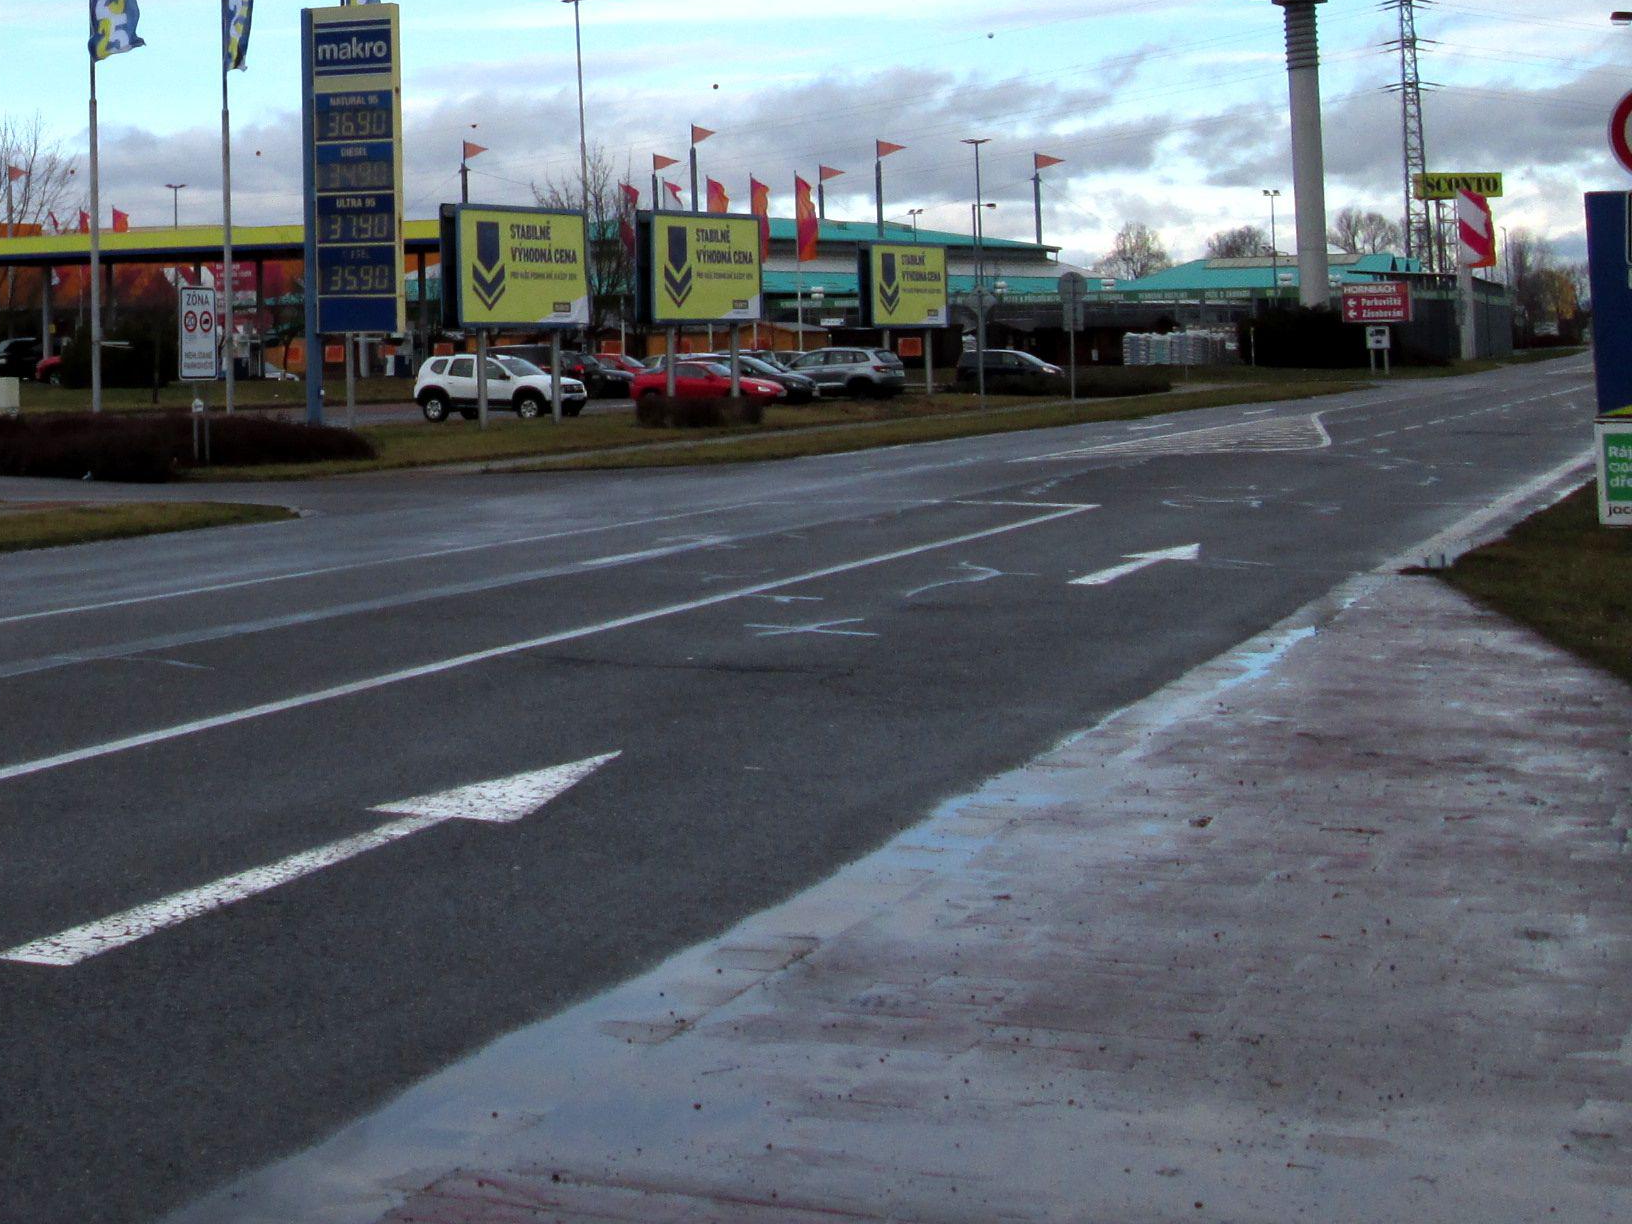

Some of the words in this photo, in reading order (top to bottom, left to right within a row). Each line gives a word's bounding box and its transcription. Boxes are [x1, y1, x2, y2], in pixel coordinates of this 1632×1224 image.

[317, 36, 387, 60] makro
[330, 95, 366, 106] NATURAL
[340, 147, 368, 158] DIESEL
[1425, 176, 1498, 192] SCONTO
[336, 198, 362, 208] ULTRA
[554, 248, 577, 264] CENA
[733, 250, 753, 264] CENA
[1343, 285, 1396, 294] HORNBACH
[186, 291, 210, 306] ZÓNA
